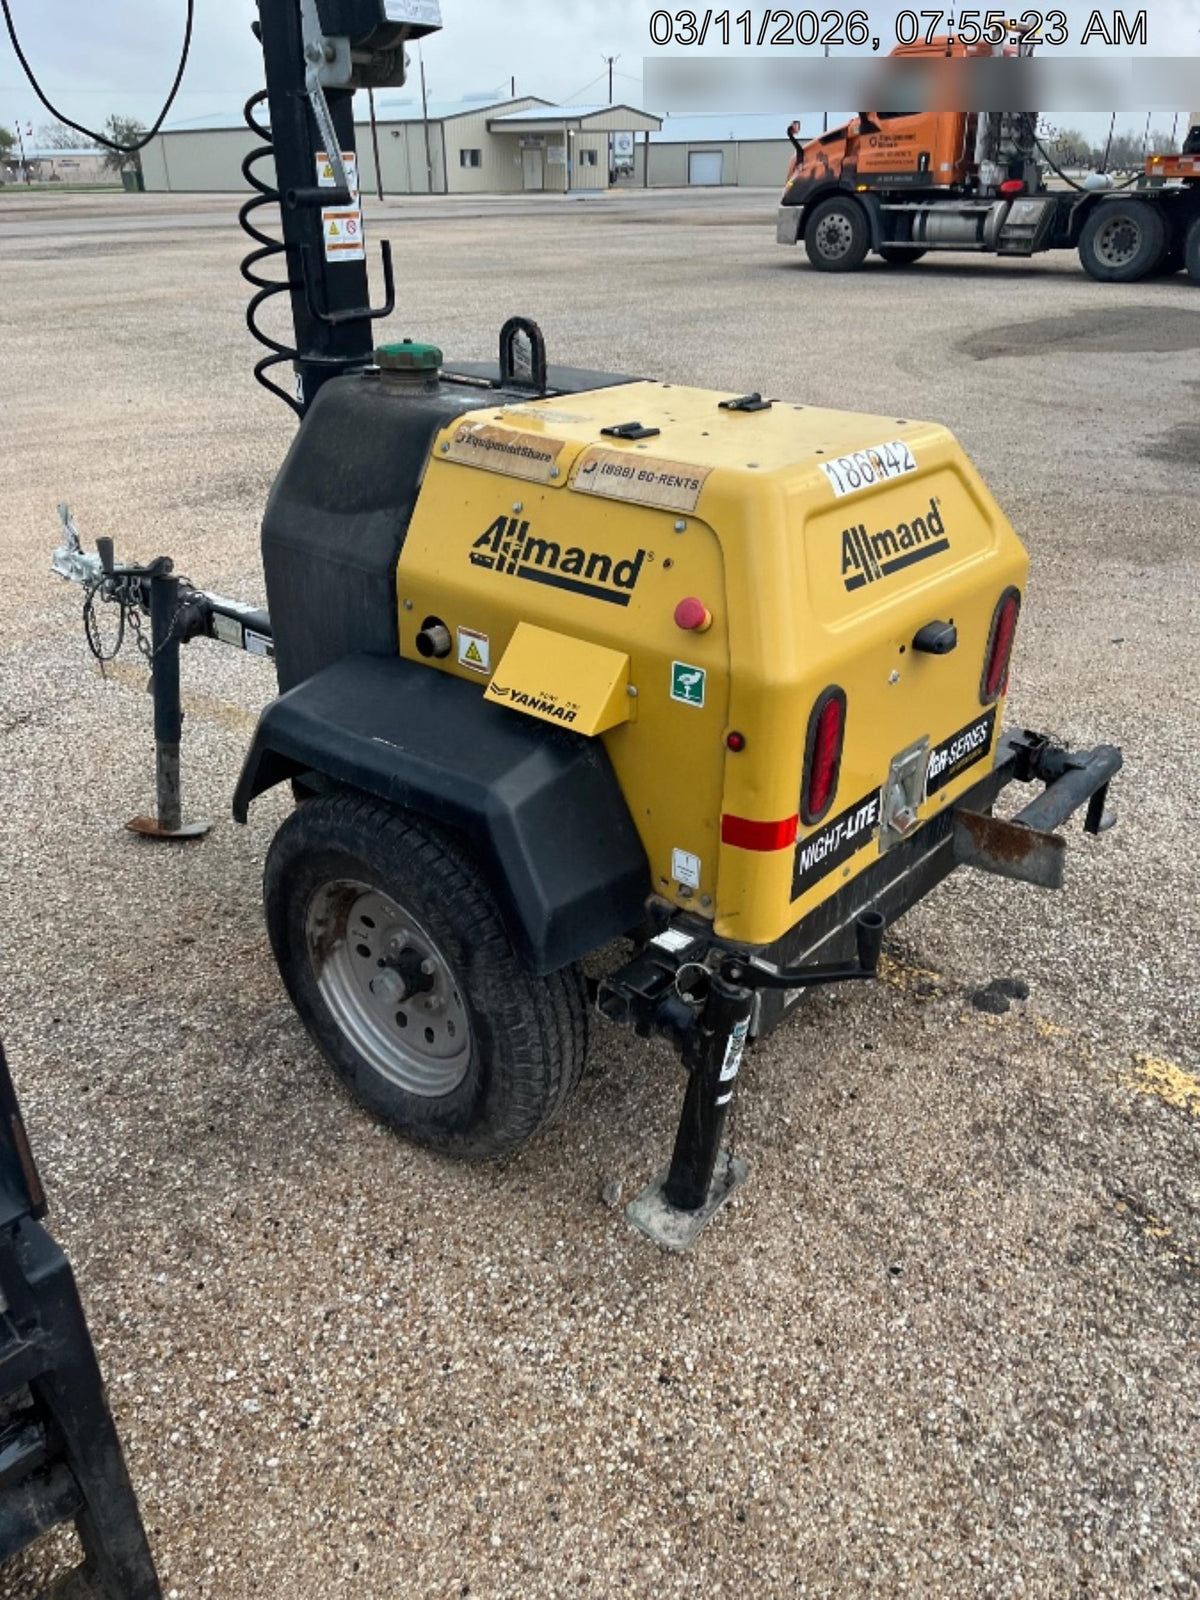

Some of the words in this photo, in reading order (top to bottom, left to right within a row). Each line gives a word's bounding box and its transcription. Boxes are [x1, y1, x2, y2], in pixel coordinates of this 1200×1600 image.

[600, 462, 635, 479] (888)
[637, 470, 700, 490] 80-RENTS
[470, 515, 647, 592] Allmand
[842, 496, 946, 584] Allmand
[509, 689, 578, 723] YANMAR
[799, 798, 879, 876] NIGHT-LITE
